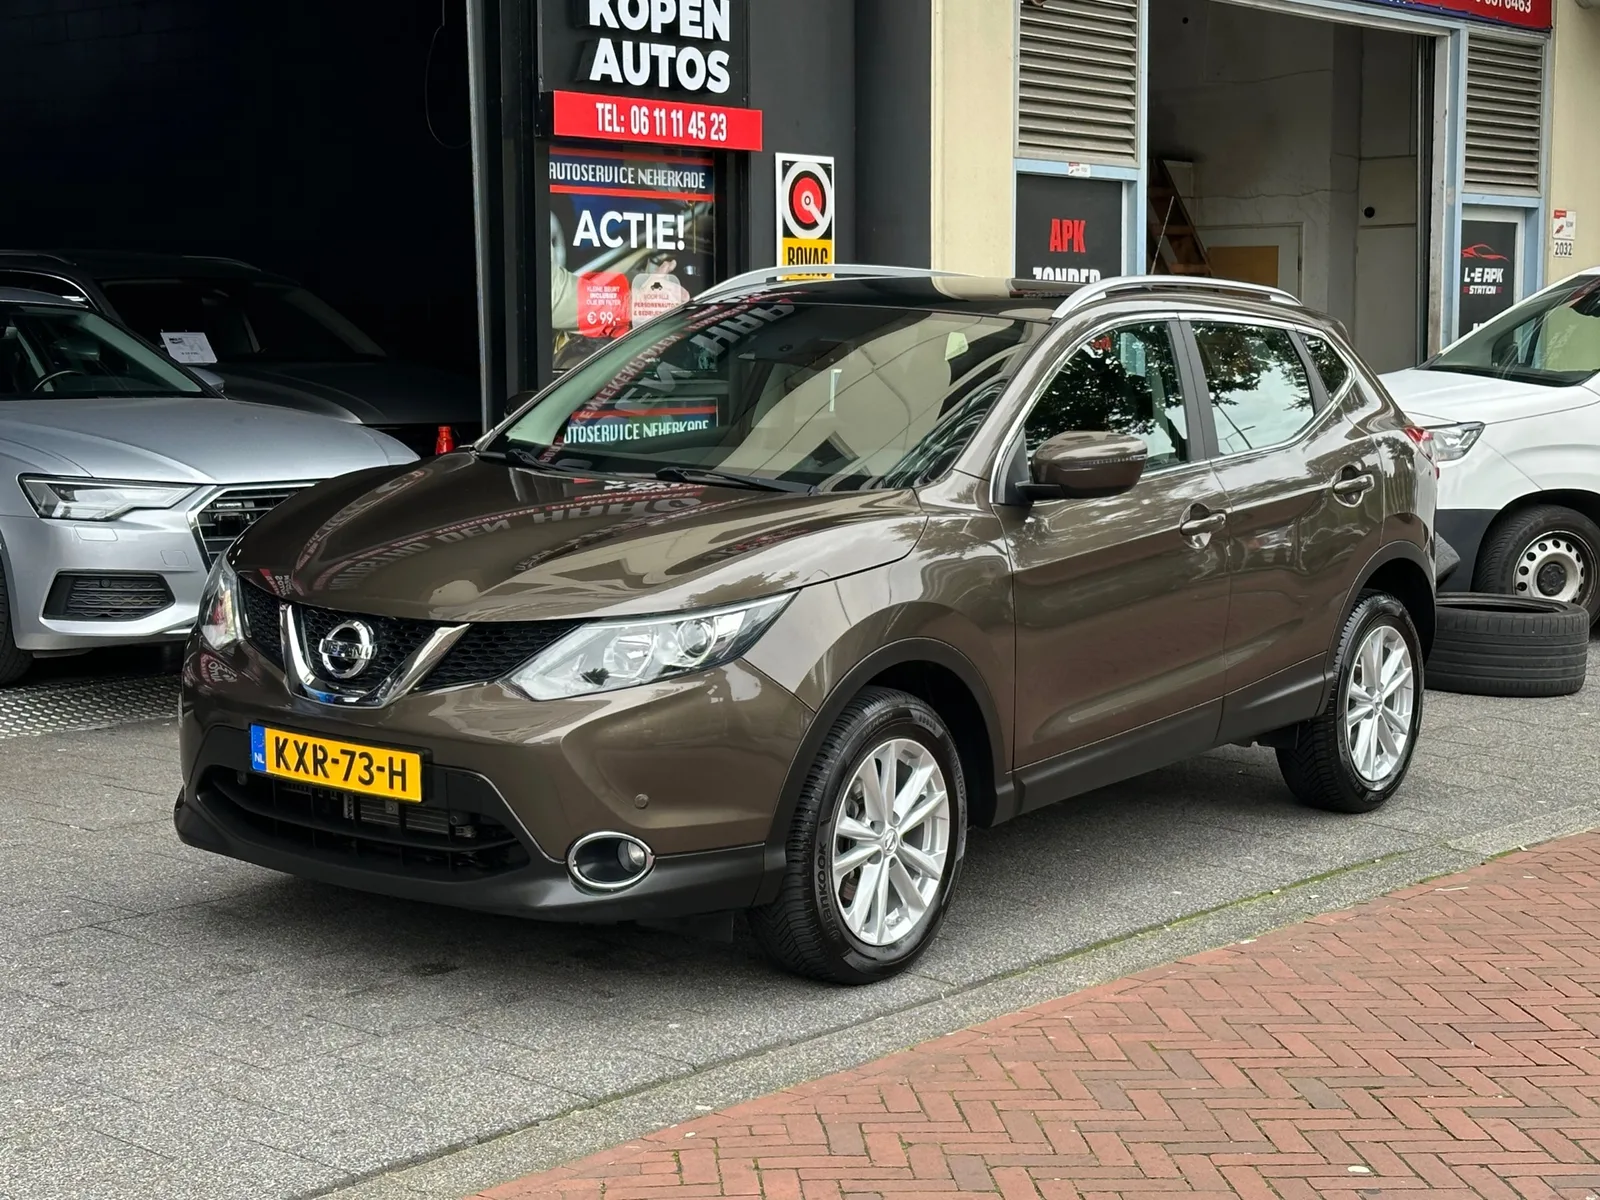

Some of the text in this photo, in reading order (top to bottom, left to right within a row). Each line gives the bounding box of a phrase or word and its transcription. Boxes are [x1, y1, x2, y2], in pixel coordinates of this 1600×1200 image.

[590, 0, 730, 42] KOPEN
[589, 38, 731, 94] AUTOS
[595, 102, 727, 142] TEL: 06 11 11 45 23
[549, 161, 706, 189] AUTOSERVICE NEHERKADE
[572, 209, 686, 251] ACTIE!
[1049, 218, 1086, 253] APK
[1555, 242, 1572, 256] 2032
[1469, 285, 1497, 295] STATION
[1483, 268, 1504, 283] APK
[600, 312, 621, 326] 99,-
[254, 752, 264, 764] NL
[274, 735, 407, 792] KXR-73-H
